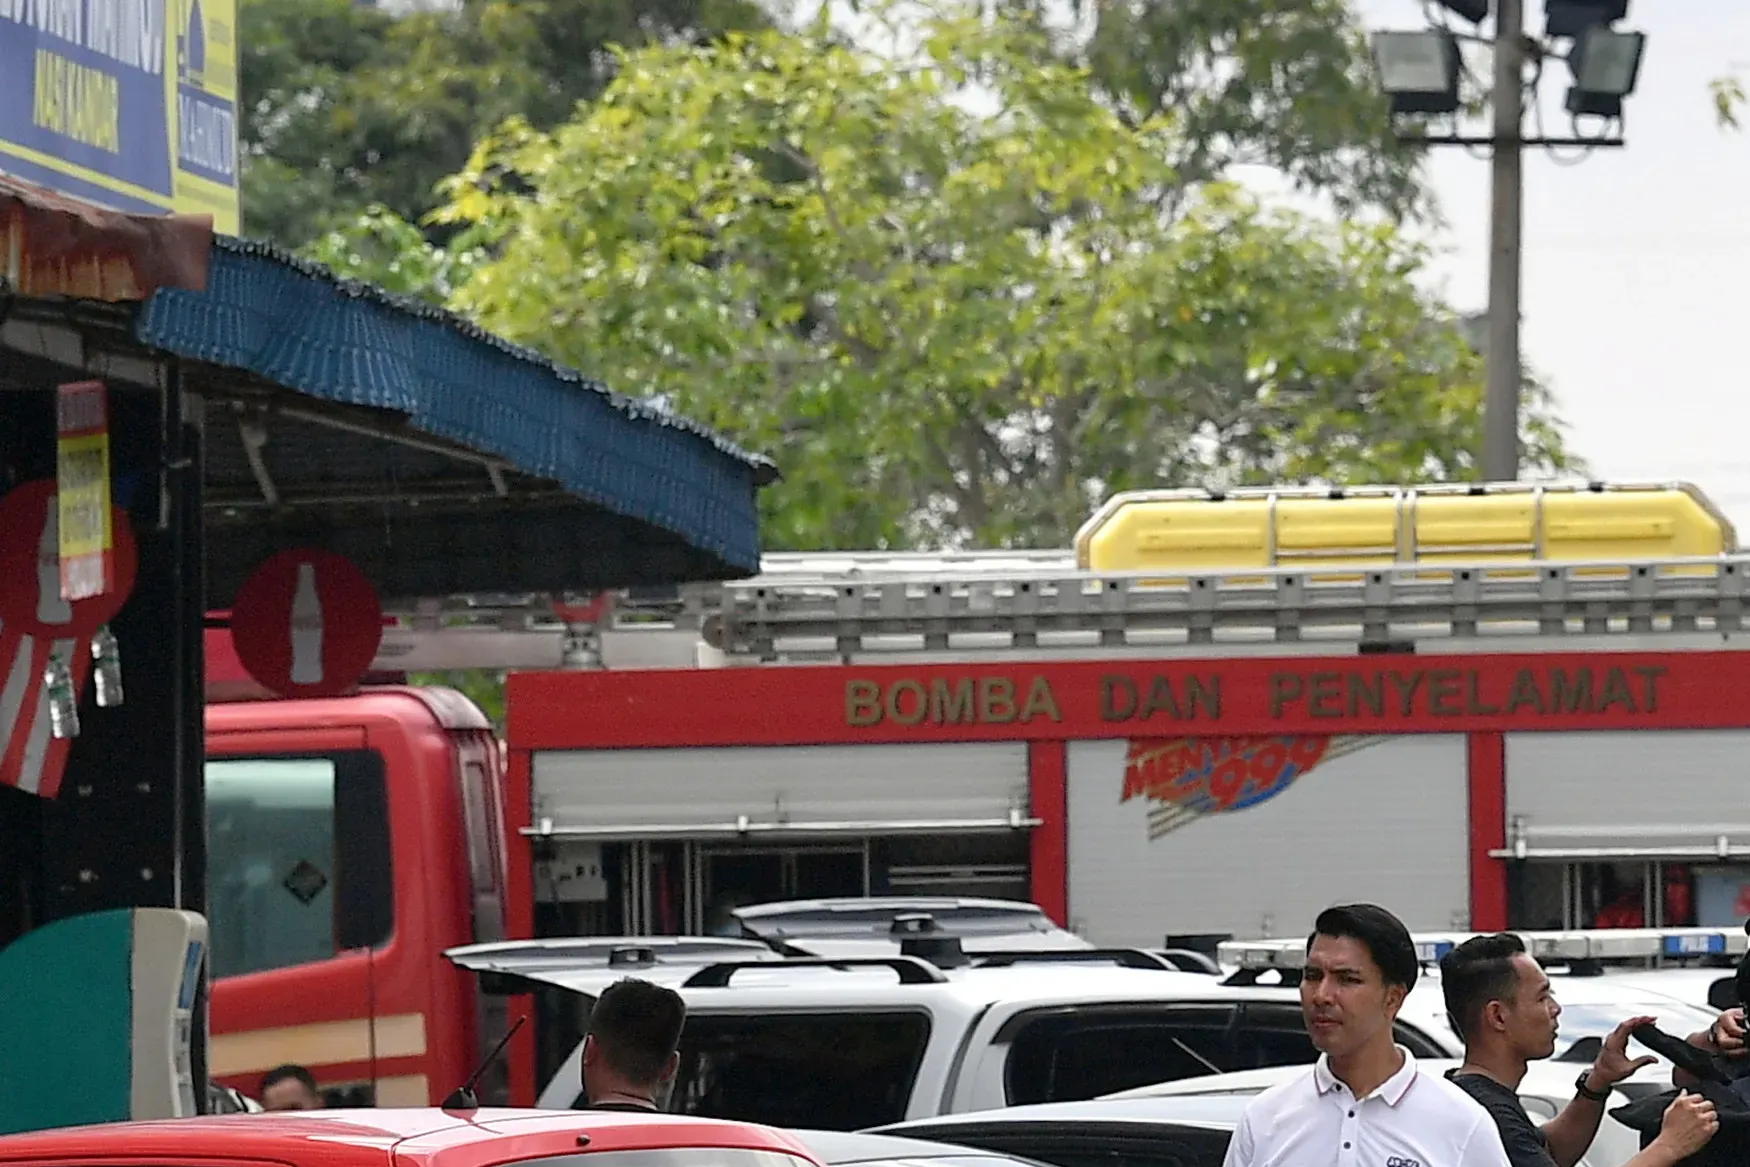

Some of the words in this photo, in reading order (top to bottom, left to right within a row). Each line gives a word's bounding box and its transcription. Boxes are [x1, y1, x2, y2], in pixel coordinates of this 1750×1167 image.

[843, 676, 1062, 727] BOMBA
[1102, 674, 1222, 721] DAN
[1270, 666, 1668, 719] PENYELAMAT
